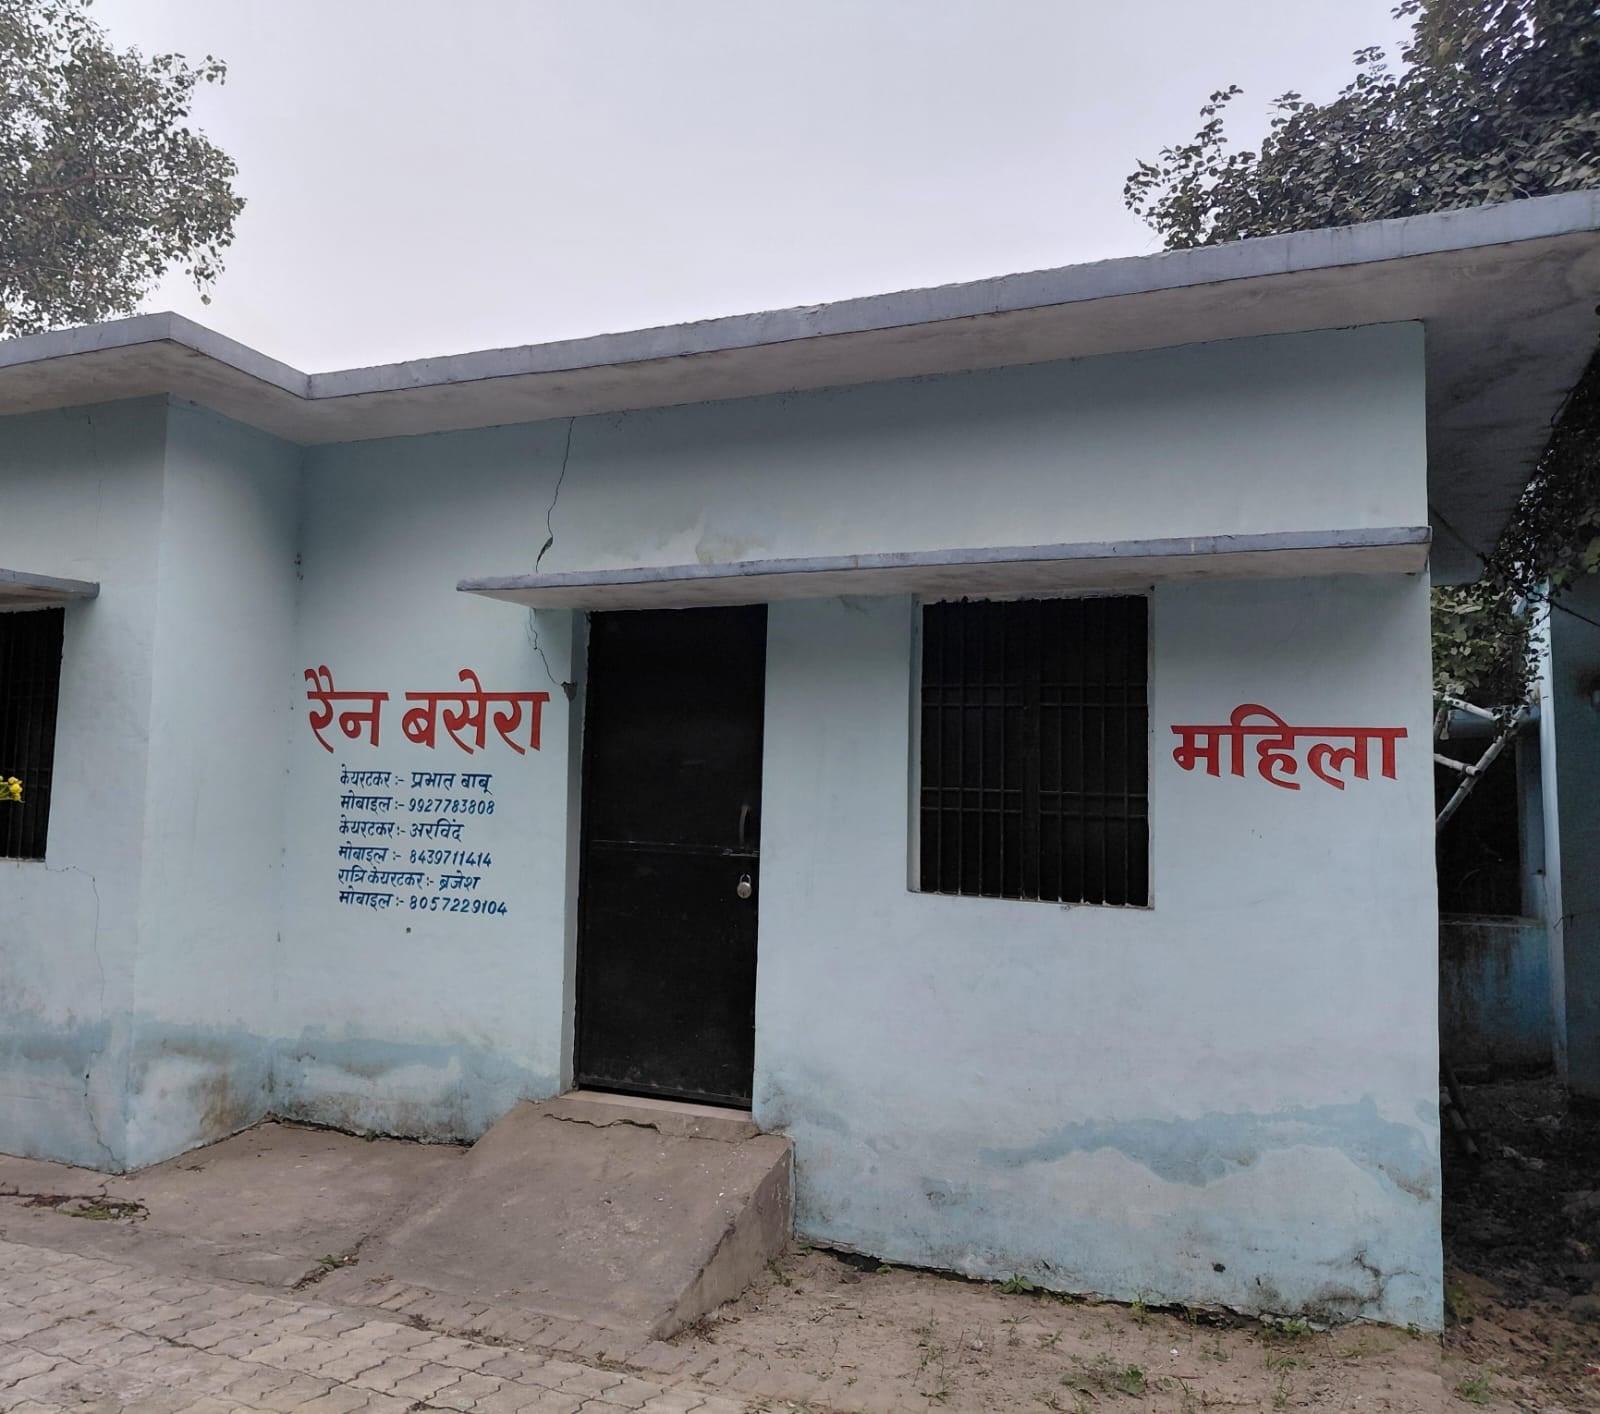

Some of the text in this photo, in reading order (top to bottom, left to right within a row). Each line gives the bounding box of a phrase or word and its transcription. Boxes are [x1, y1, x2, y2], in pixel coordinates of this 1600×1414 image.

[304, 665, 550, 755] रैन बसेरा
[1170, 704, 1408, 790] महिला
[411, 771, 456, 791] प्रभात
[408, 797, 495, 815] 9927783808
[409, 849, 492, 867] 8439711414
[409, 896, 508, 916] 8057229104
